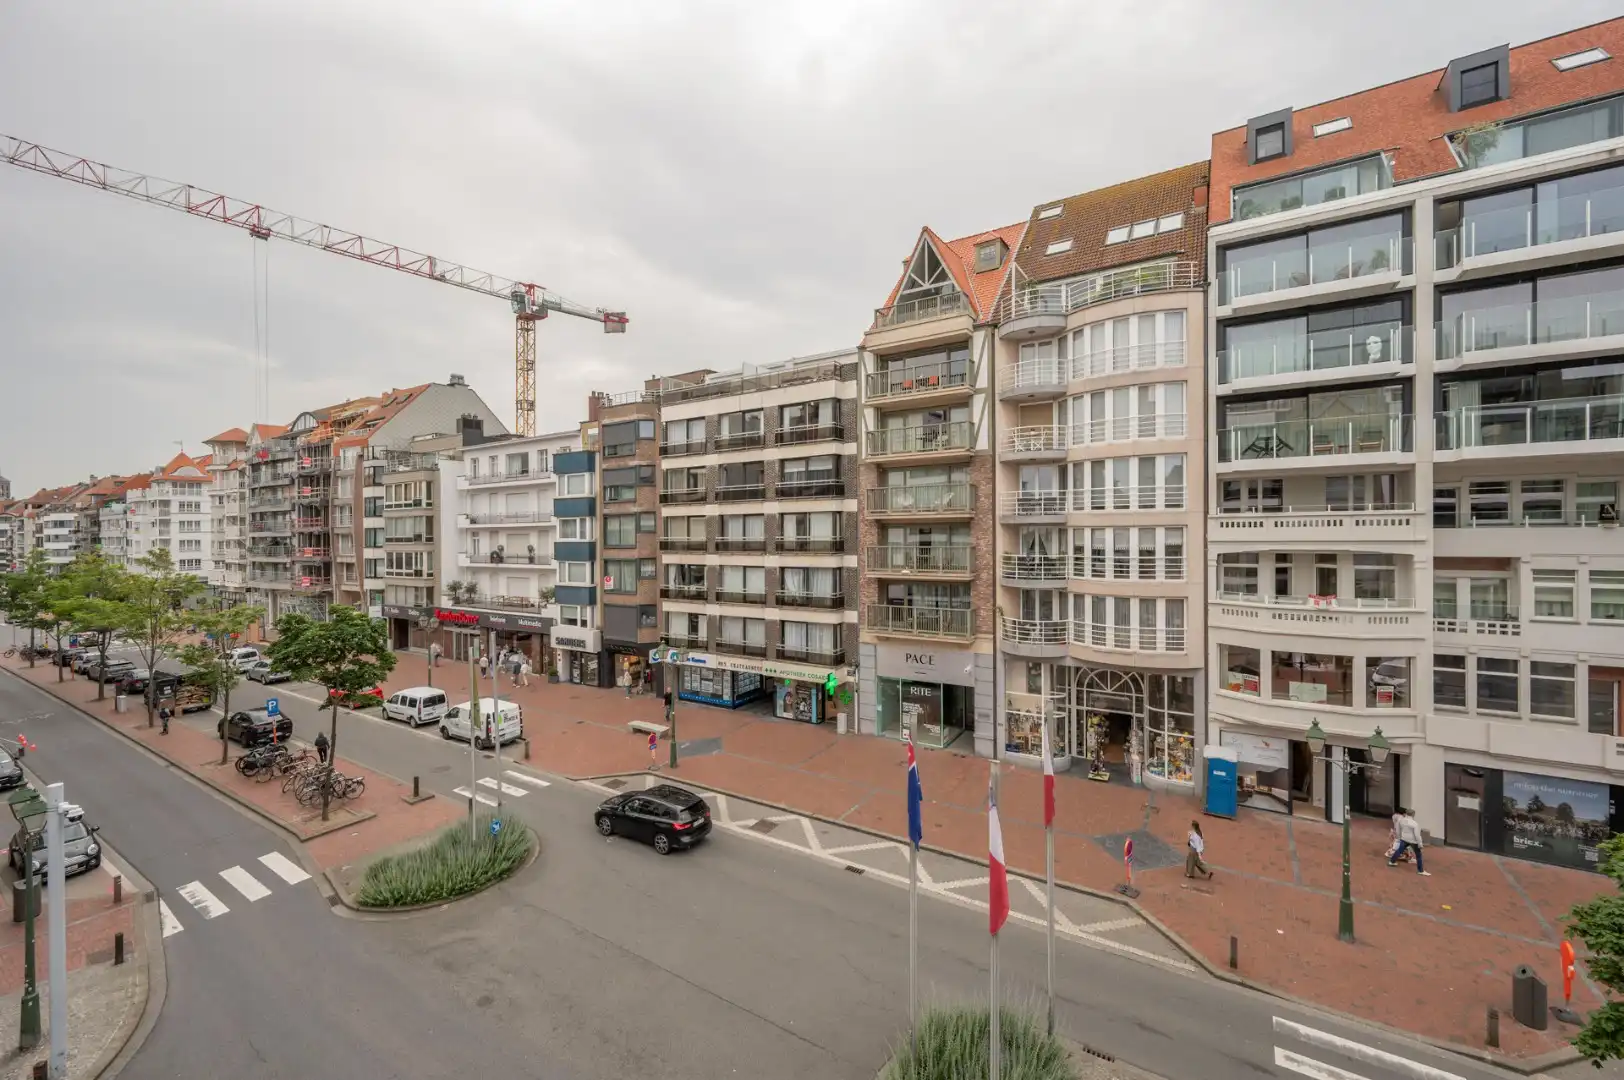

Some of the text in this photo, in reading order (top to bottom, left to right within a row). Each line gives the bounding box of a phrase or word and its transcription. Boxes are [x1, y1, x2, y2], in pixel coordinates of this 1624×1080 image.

[905, 653, 936, 665] PACE
[910, 686, 932, 697] RITE
[268, 700, 277, 712] P
